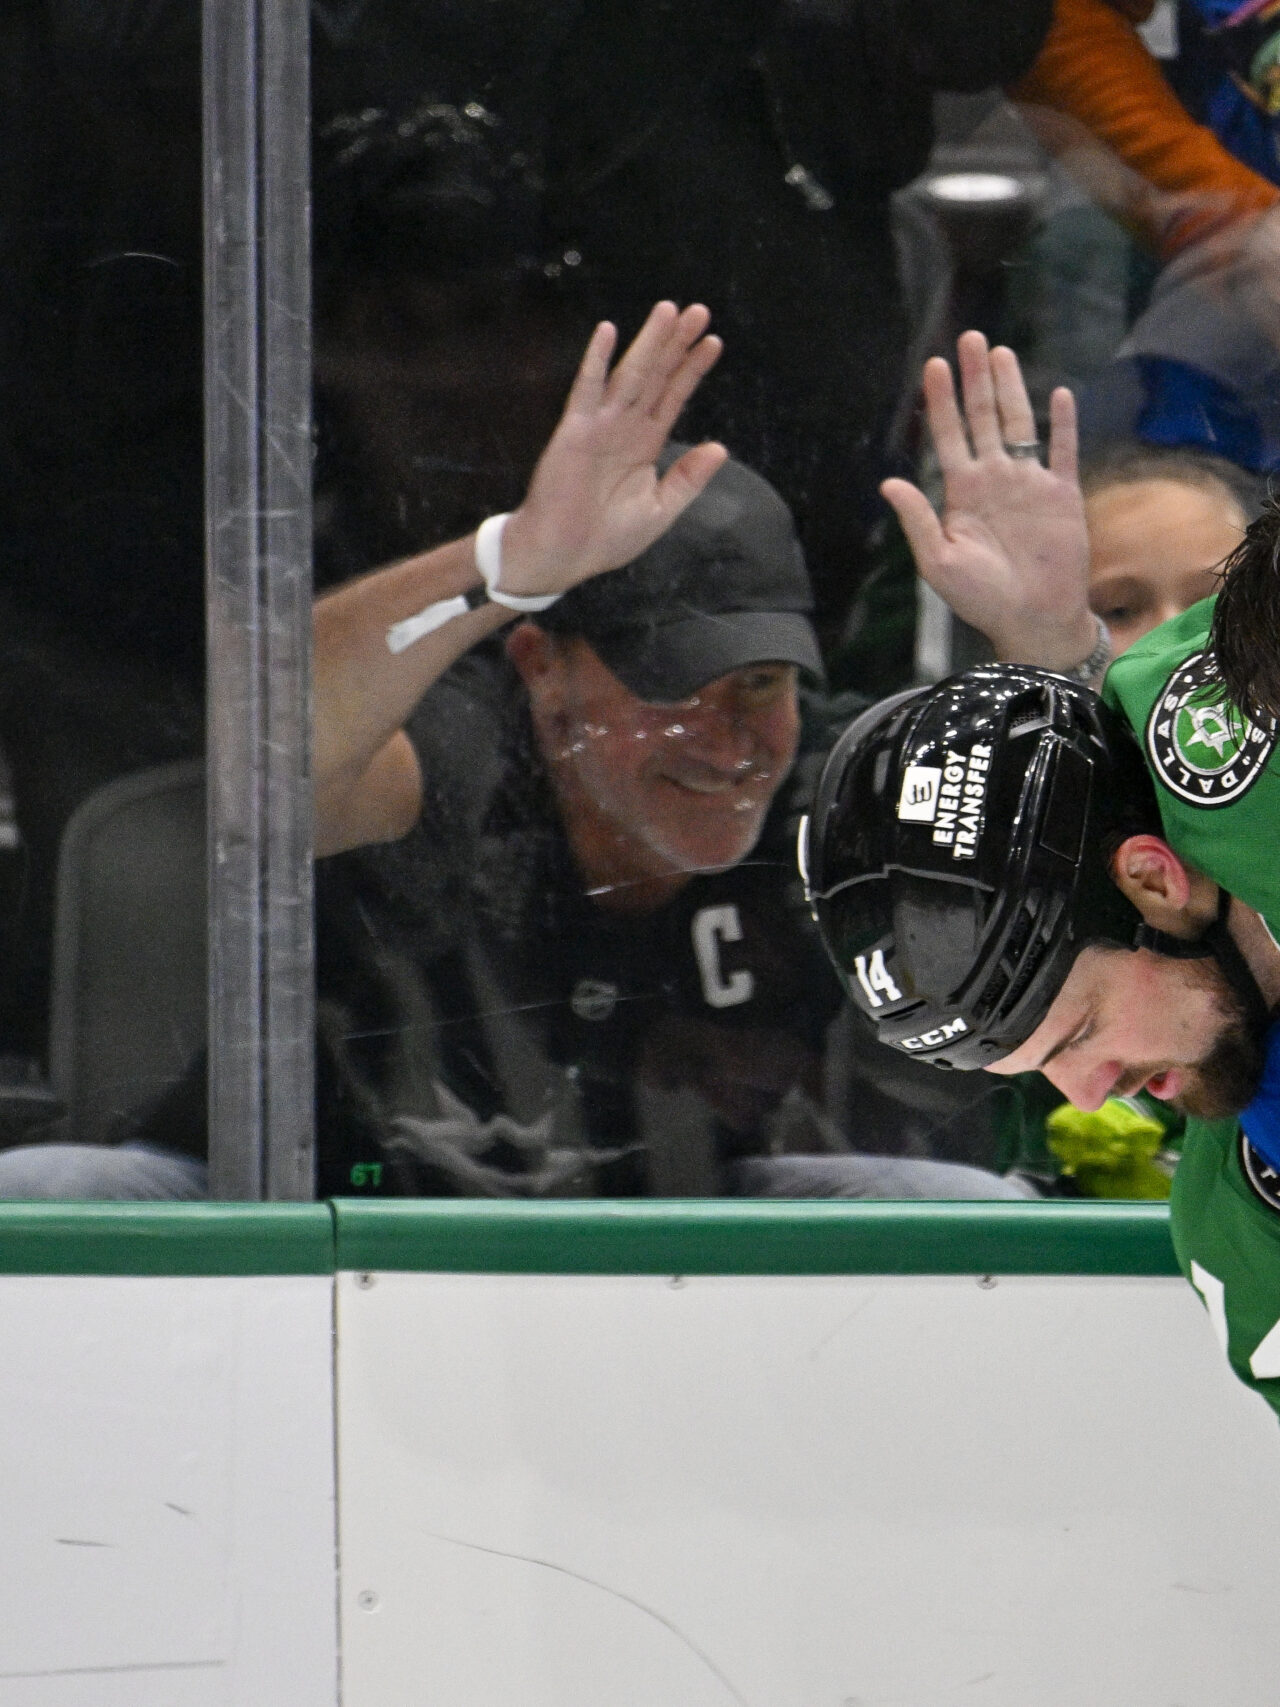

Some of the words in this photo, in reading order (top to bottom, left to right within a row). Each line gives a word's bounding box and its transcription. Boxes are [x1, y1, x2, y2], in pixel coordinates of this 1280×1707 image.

[933, 750, 967, 844] ENERGY
[953, 744, 992, 858] TRANSFER
[692, 903, 756, 1009] C
[855, 949, 903, 1008] 14
[901, 1017, 968, 1049] CCM
